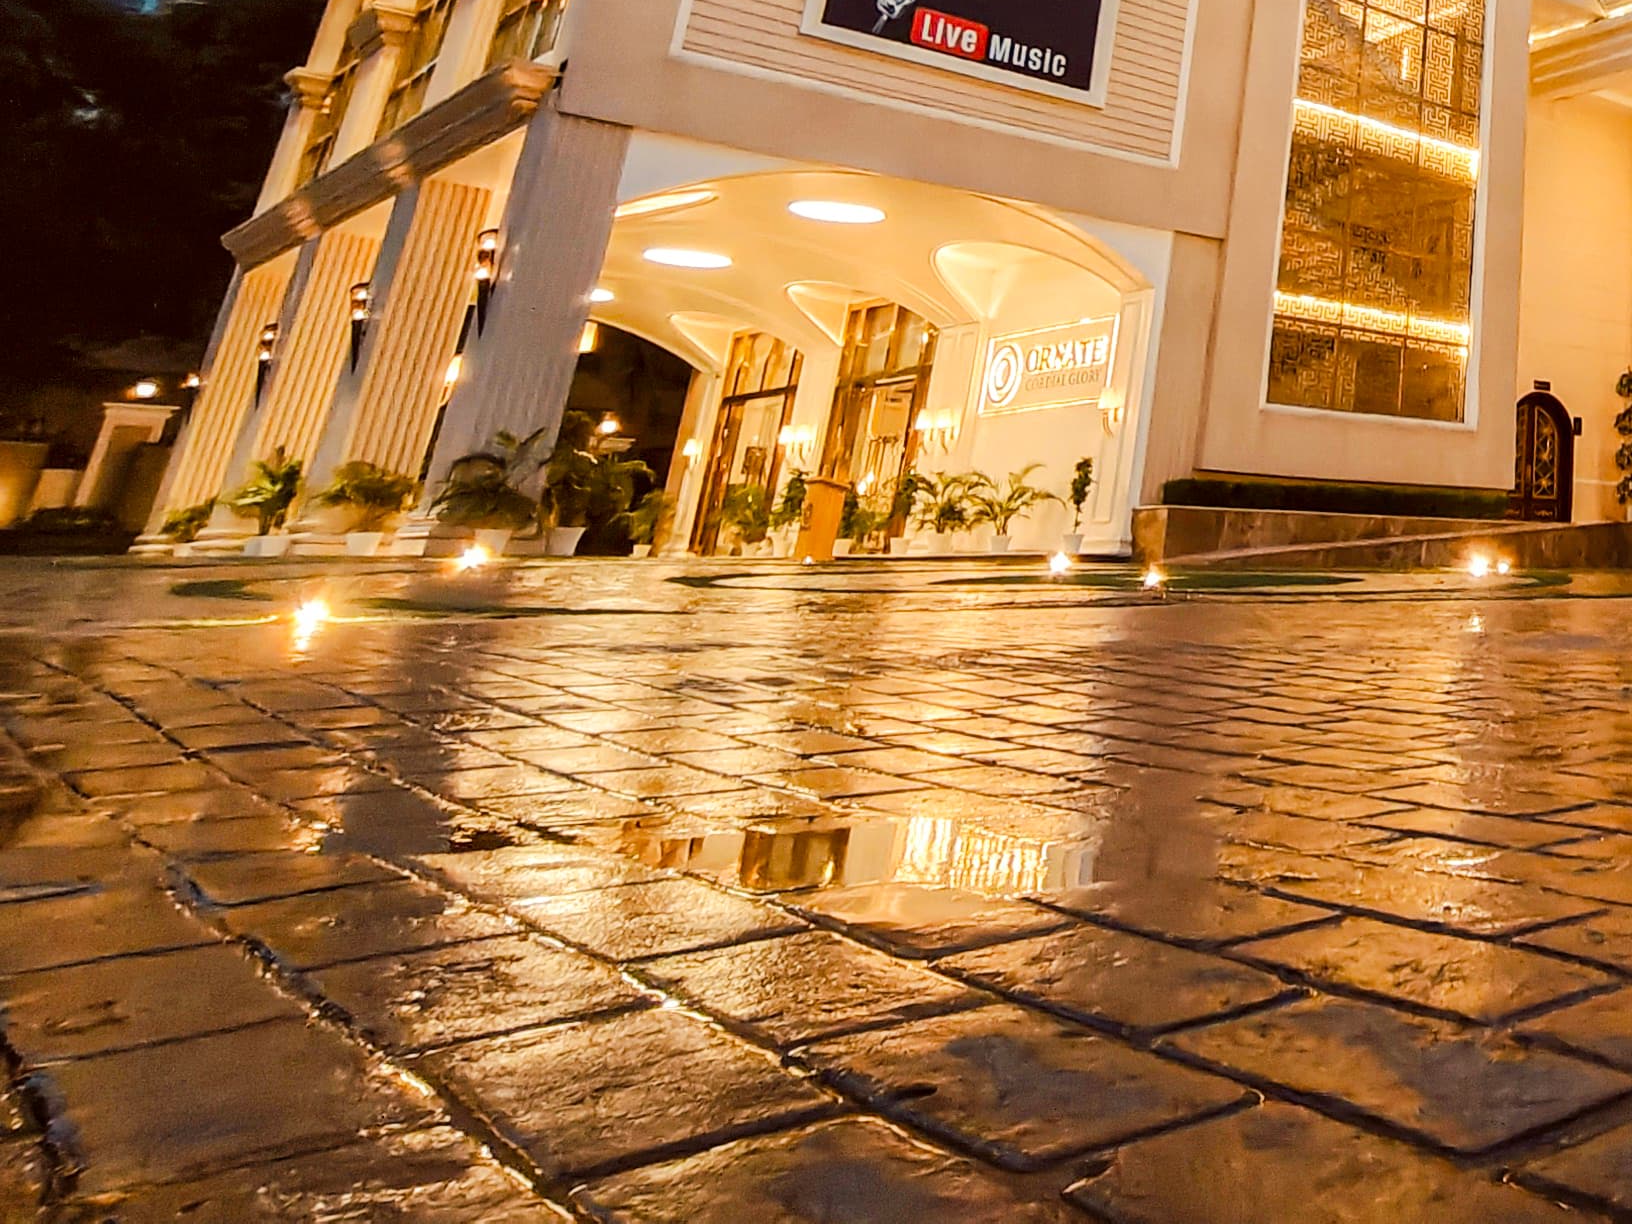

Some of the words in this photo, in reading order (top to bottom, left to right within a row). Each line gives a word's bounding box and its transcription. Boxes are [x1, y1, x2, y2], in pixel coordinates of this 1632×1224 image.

[921, 13, 978, 53] Live
[989, 33, 1067, 76] Music
[1026, 336, 1107, 374] ORNATE
